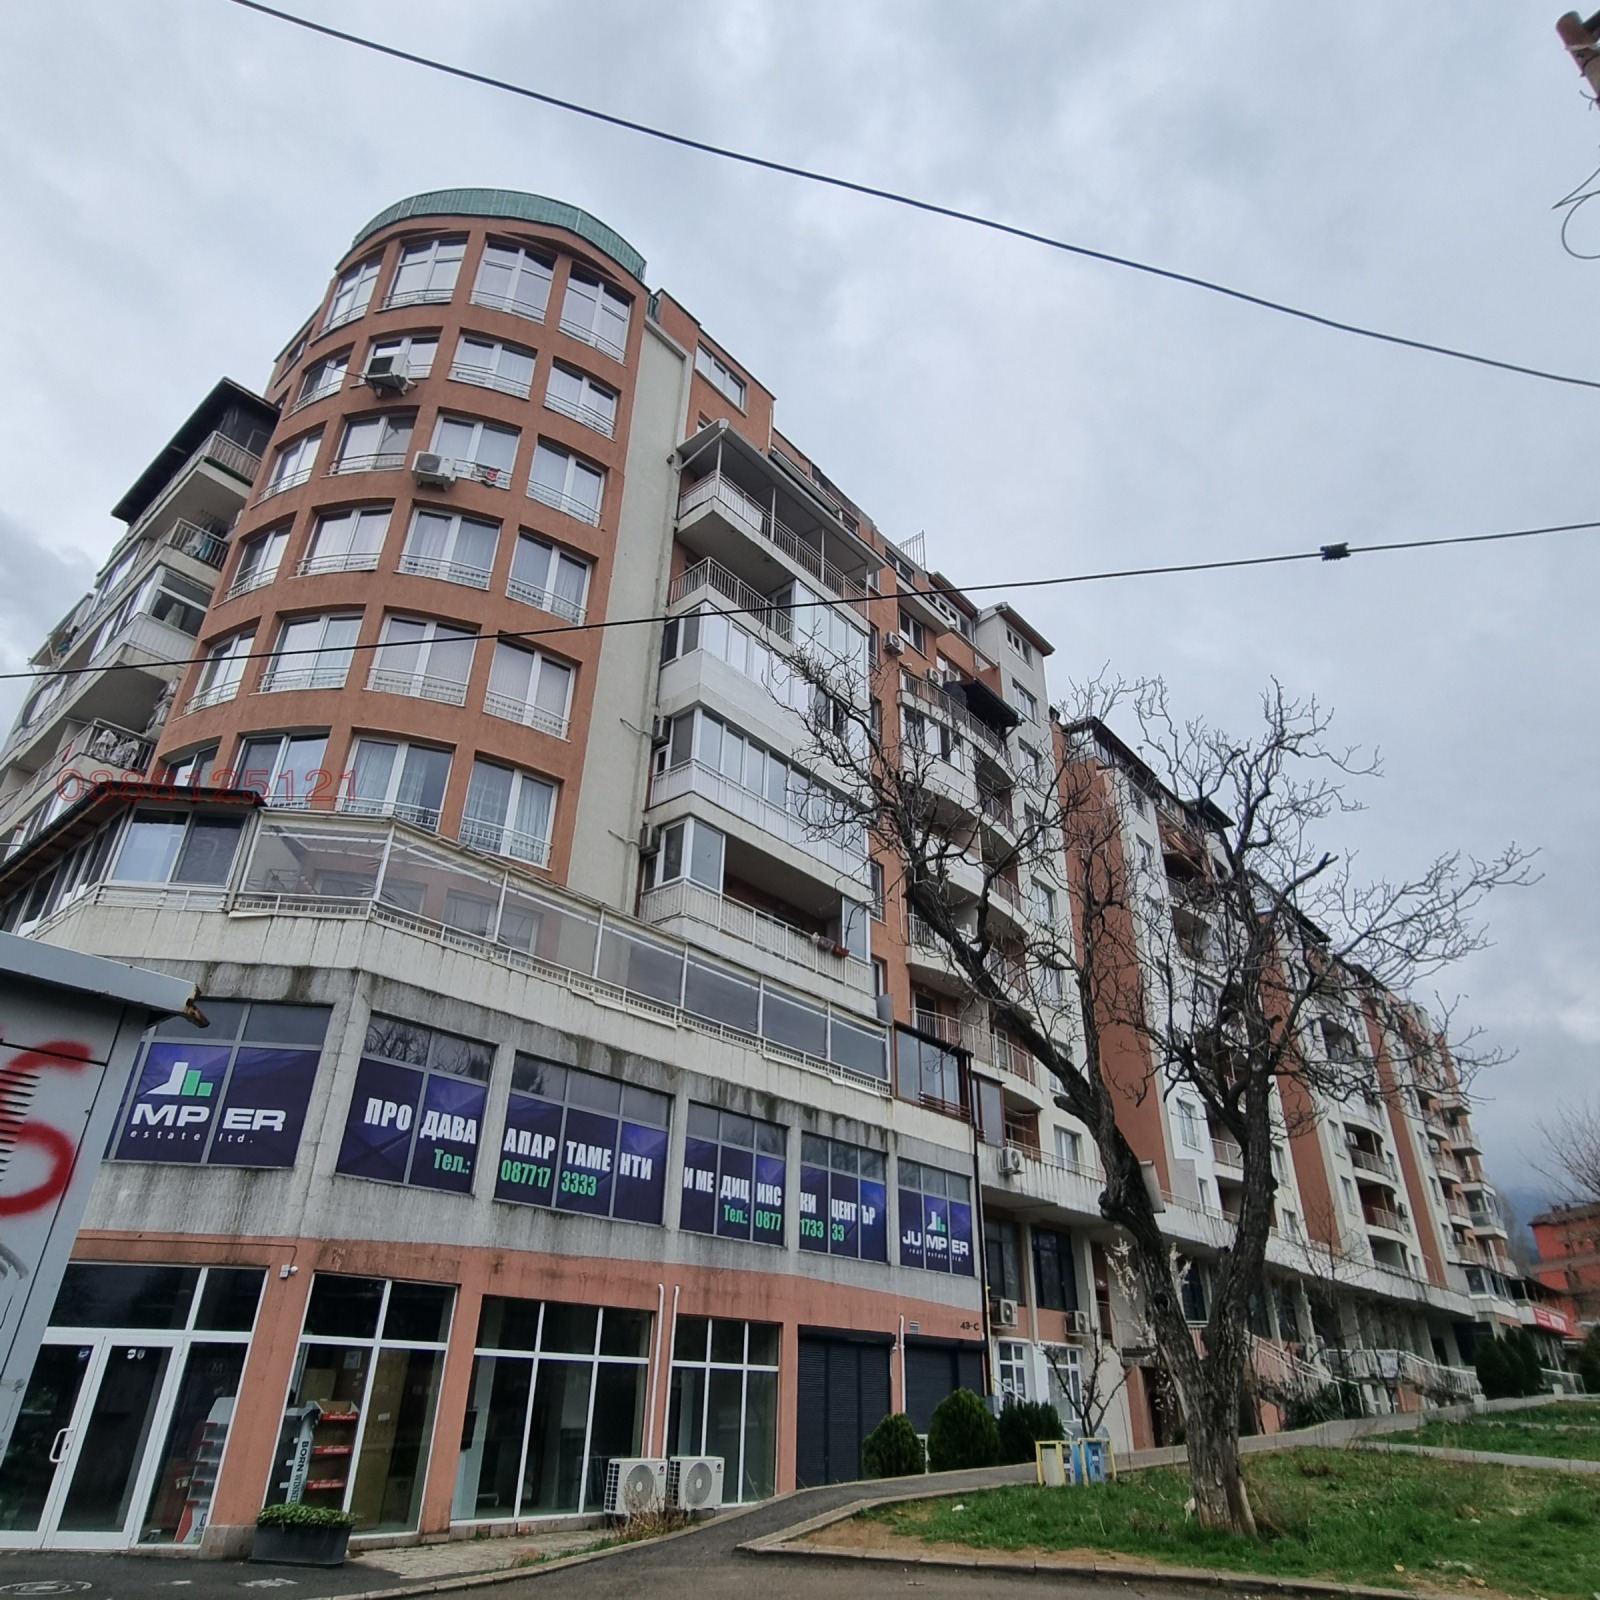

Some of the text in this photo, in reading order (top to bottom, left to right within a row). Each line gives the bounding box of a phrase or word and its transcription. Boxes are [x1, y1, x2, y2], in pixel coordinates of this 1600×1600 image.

[130, 1130, 254, 1144] estate ltd.
[434, 1148, 471, 1175] Тел.:
[296, 1440, 310, 1473] BORN
